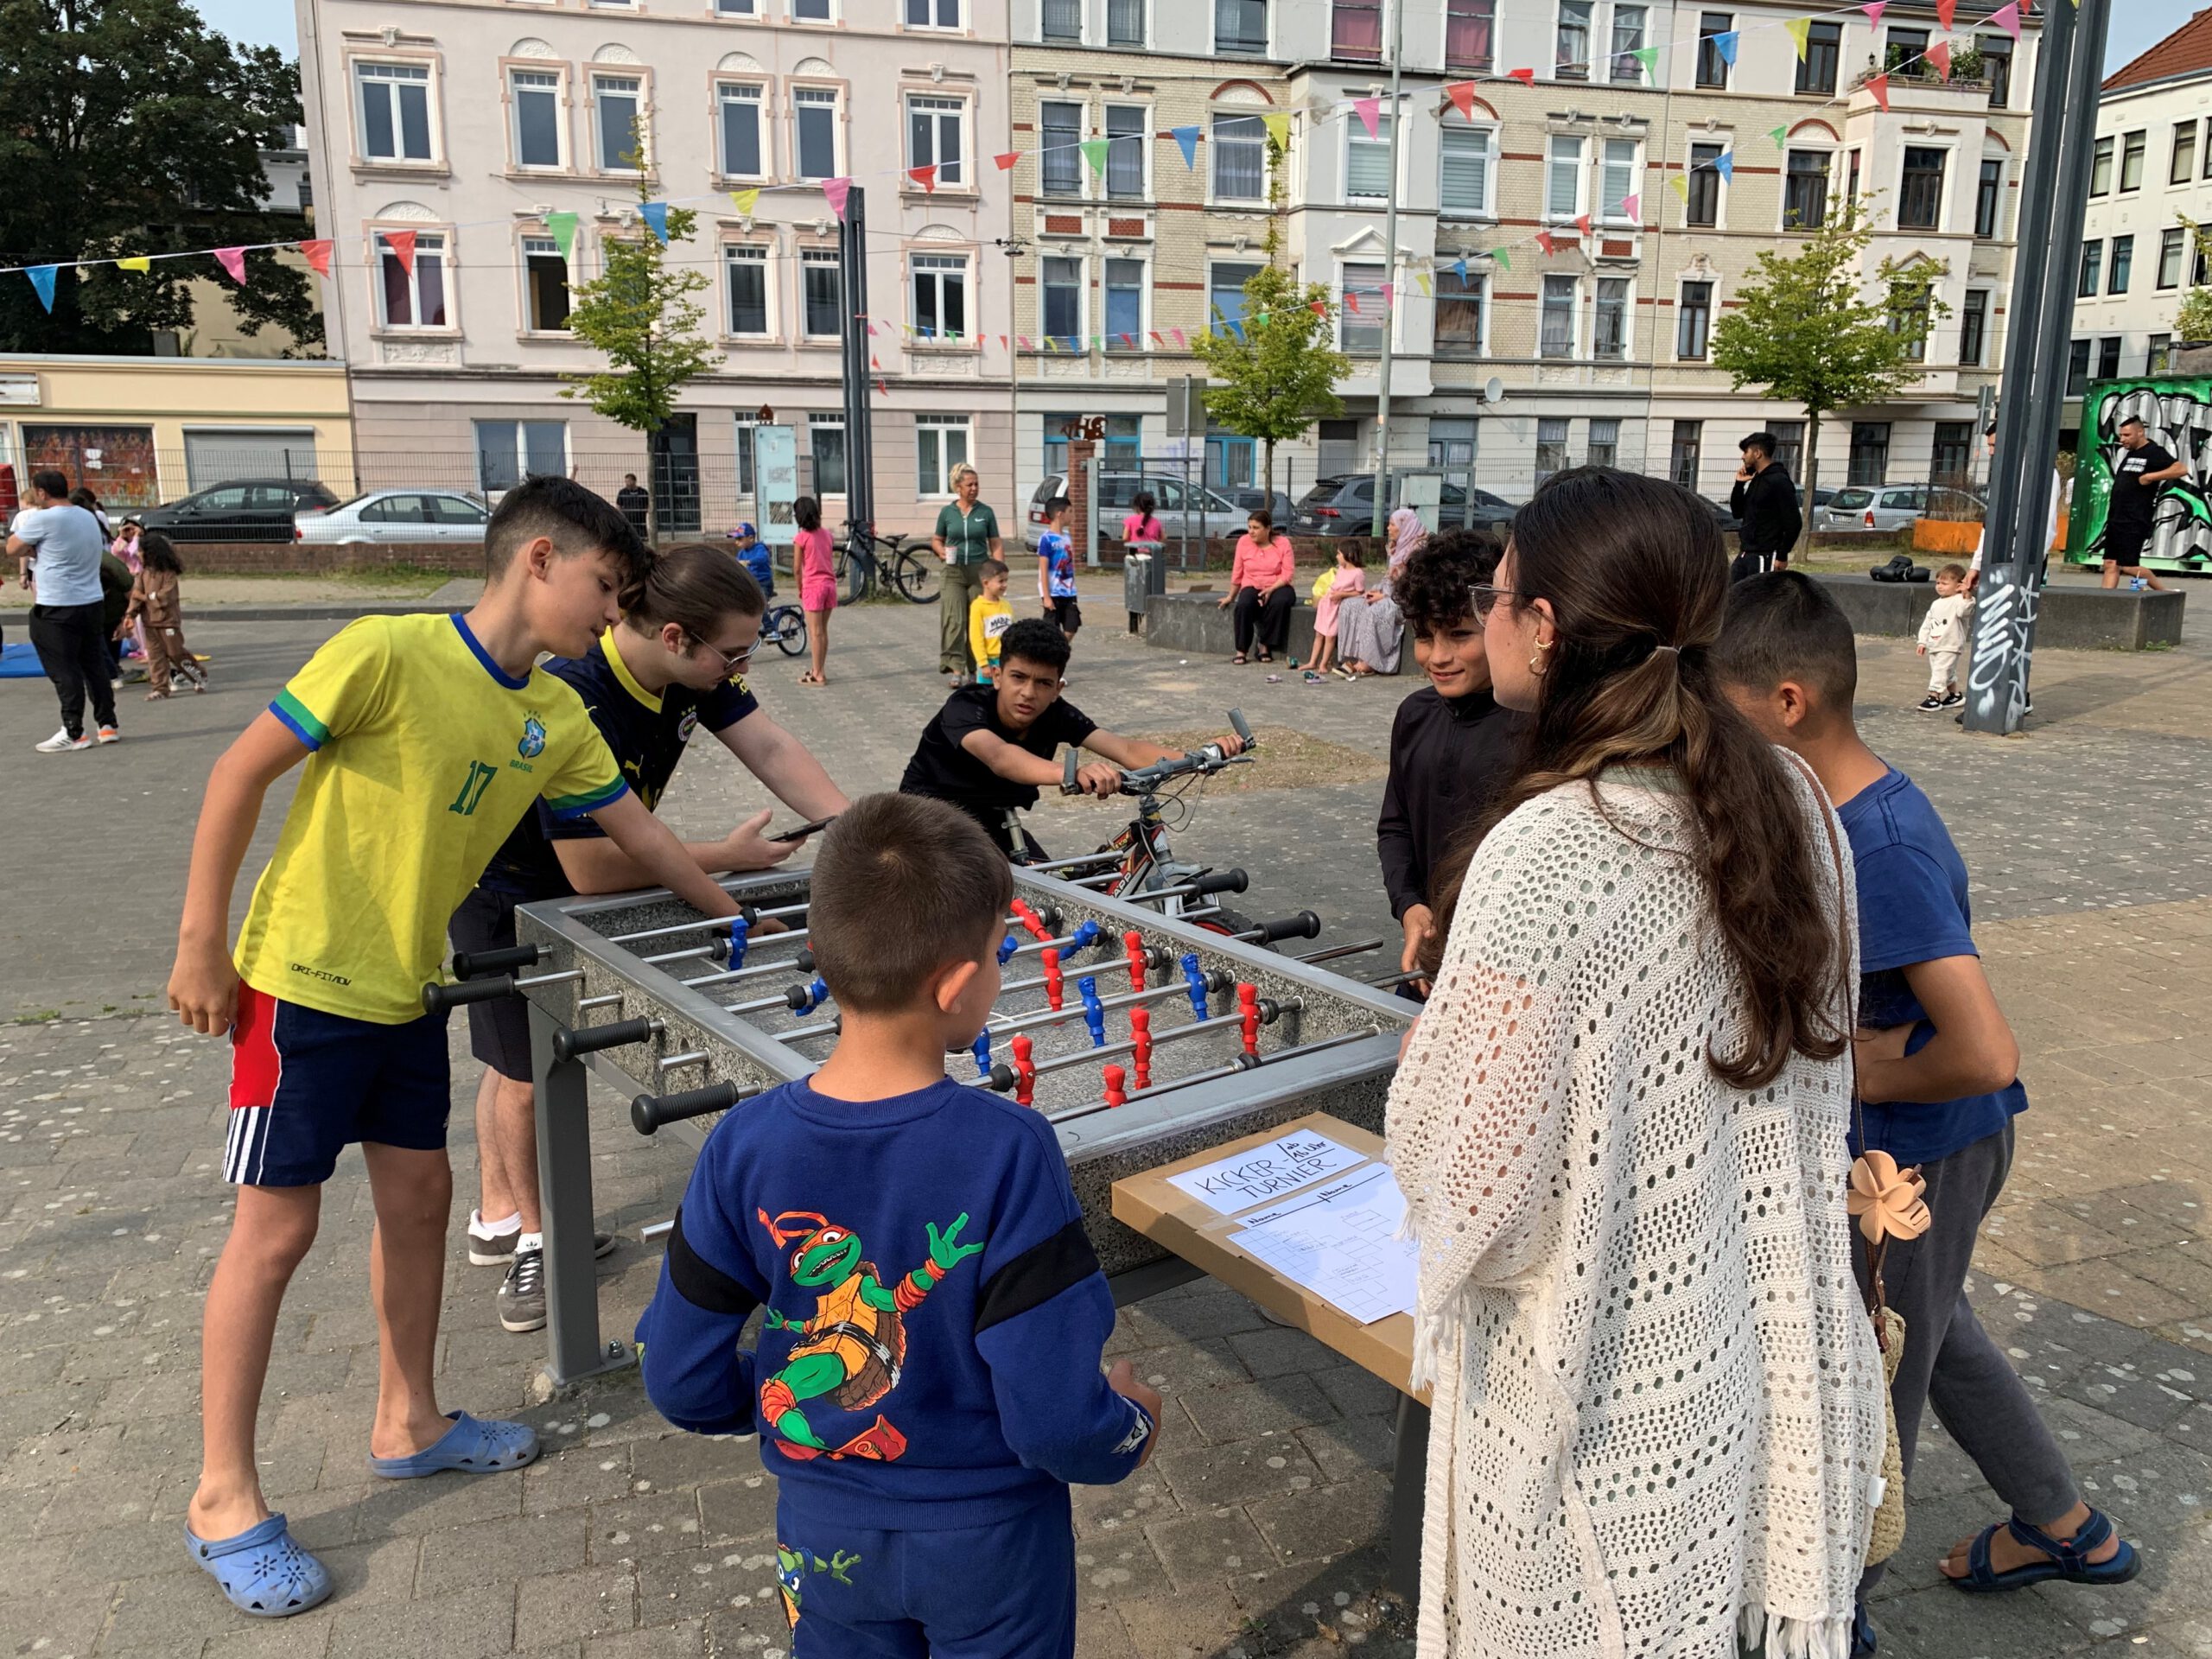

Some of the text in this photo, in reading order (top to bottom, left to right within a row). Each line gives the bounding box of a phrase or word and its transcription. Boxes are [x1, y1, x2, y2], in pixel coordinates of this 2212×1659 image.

[509, 759, 533, 773] BRASIL
[448, 760, 499, 816] 17
[1307, 1141, 1327, 1153] Uhr
[1236, 1158, 1338, 1198] TURNIER
[1320, 1183, 1353, 1198] Name
[1248, 1211, 1282, 1225] Name
